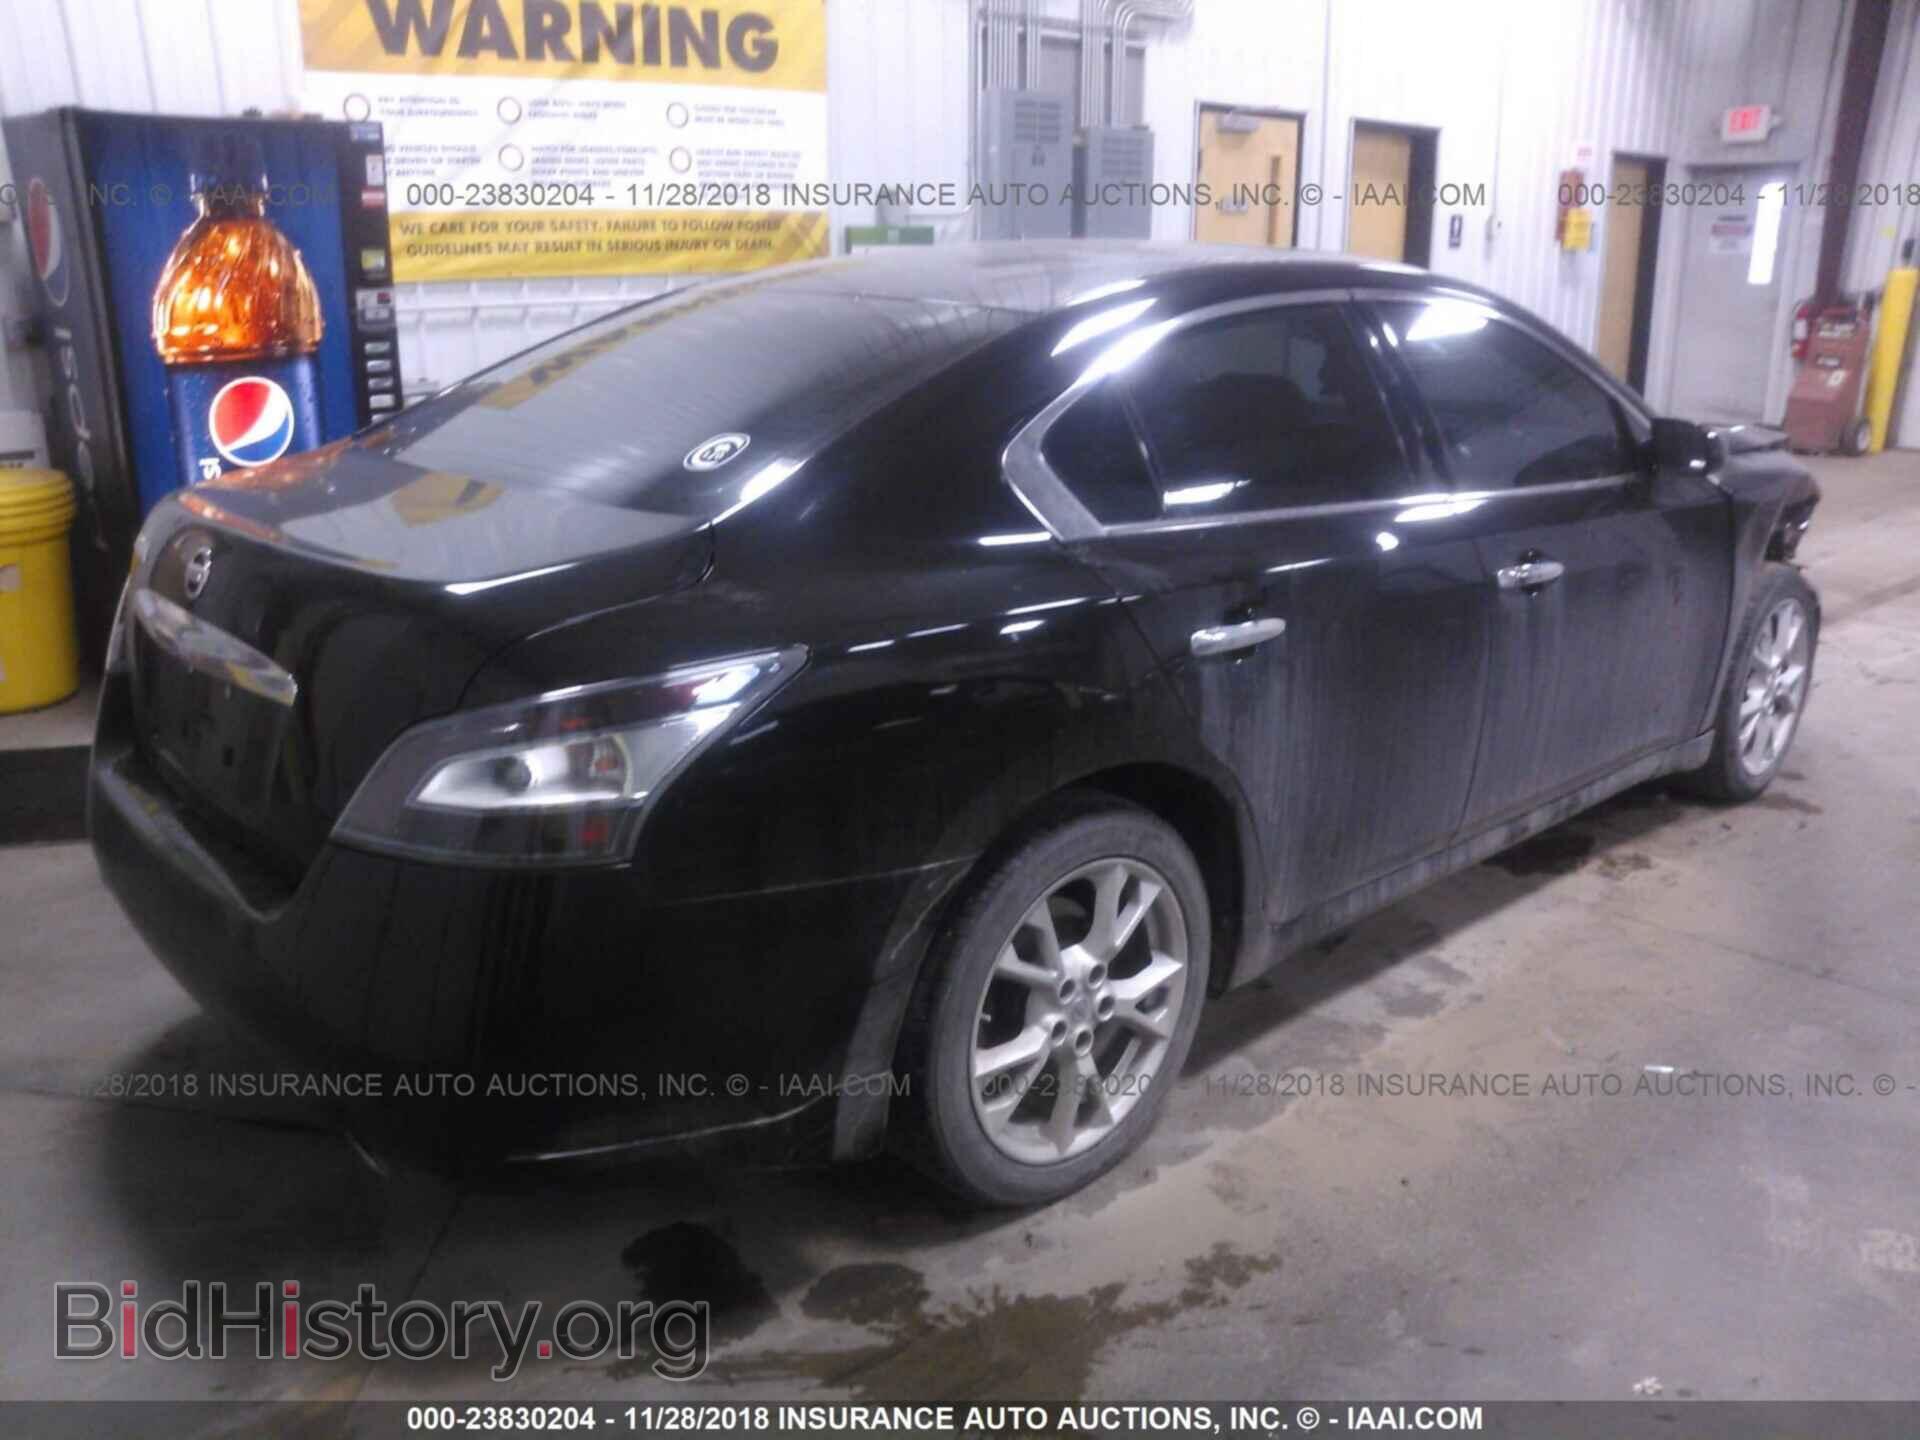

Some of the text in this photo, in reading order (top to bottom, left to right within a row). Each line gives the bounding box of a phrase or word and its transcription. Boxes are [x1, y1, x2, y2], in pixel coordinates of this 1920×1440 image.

[367, 0, 779, 73] WARNING
[400, 221, 423, 235] WE
[429, 221, 465, 235] CARE
[471, 220, 500, 234] FOR
[506, 220, 545, 233] YOUR
[661, 219, 679, 232] TO
[682, 219, 735, 231] FOLLOW
[406, 241, 494, 256] GUIDELINES
[498, 241, 530, 255] MAY
[534, 239, 583, 254] RESULT
[586, 239, 605, 252] IN
[607, 239, 663, 252] SERIOUS
